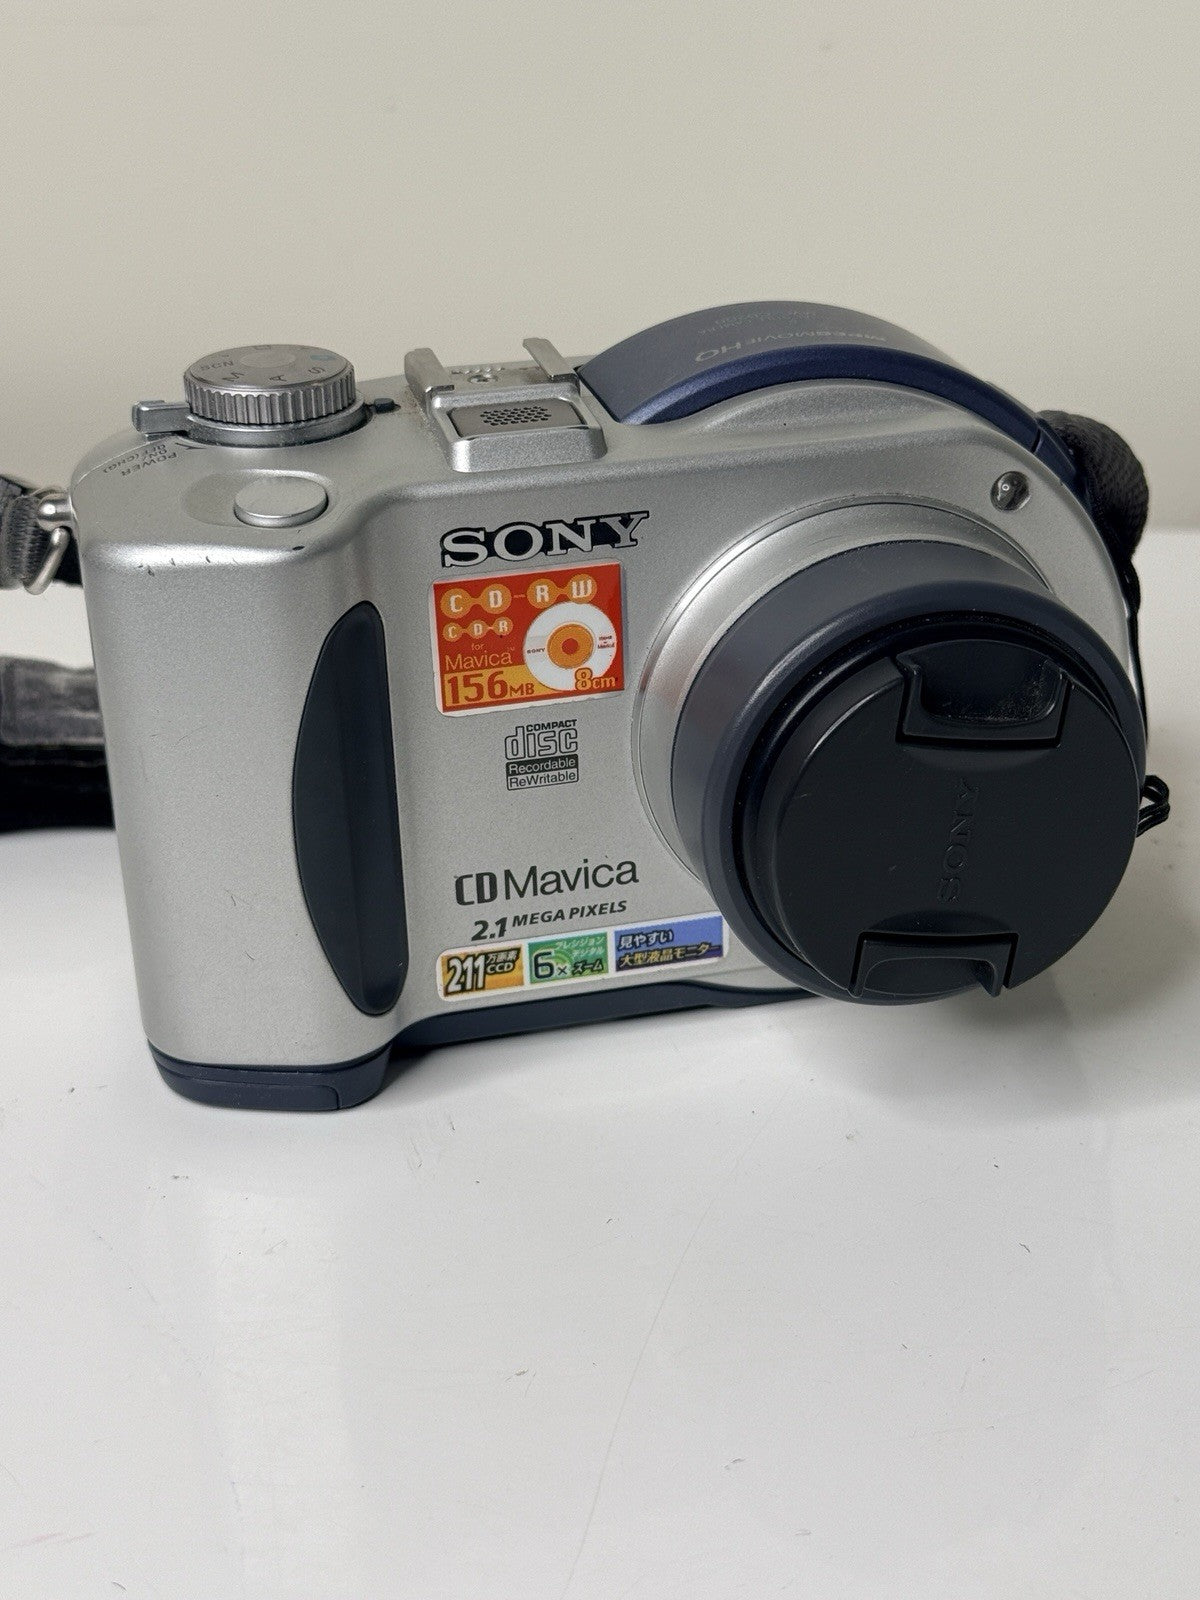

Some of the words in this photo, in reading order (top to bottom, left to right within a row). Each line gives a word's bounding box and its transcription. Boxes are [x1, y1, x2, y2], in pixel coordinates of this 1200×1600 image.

[269, 374, 287, 382] A
[121, 452, 178, 476] POWER
[440, 510, 650, 568] SONY
[471, 643, 485, 651] for
[447, 671, 535, 705] 156MB
[574, 667, 617, 691] 8cm
[516, 719, 578, 732] COMPACT
[504, 725, 579, 760] disc
[508, 757, 577, 775] Recordable
[509, 770, 577, 788] ReWritable
[936, 777, 980, 902] SONY
[503, 858, 640, 901] Mavica
[470, 917, 508, 942] 2.1
[569, 900, 628, 919] PIXELS
[618, 929, 674, 950] 見やすい
[619, 942, 721, 968] 大型液晶モニター
[446, 953, 486, 993] 211
[486, 962, 514, 974] CCD
